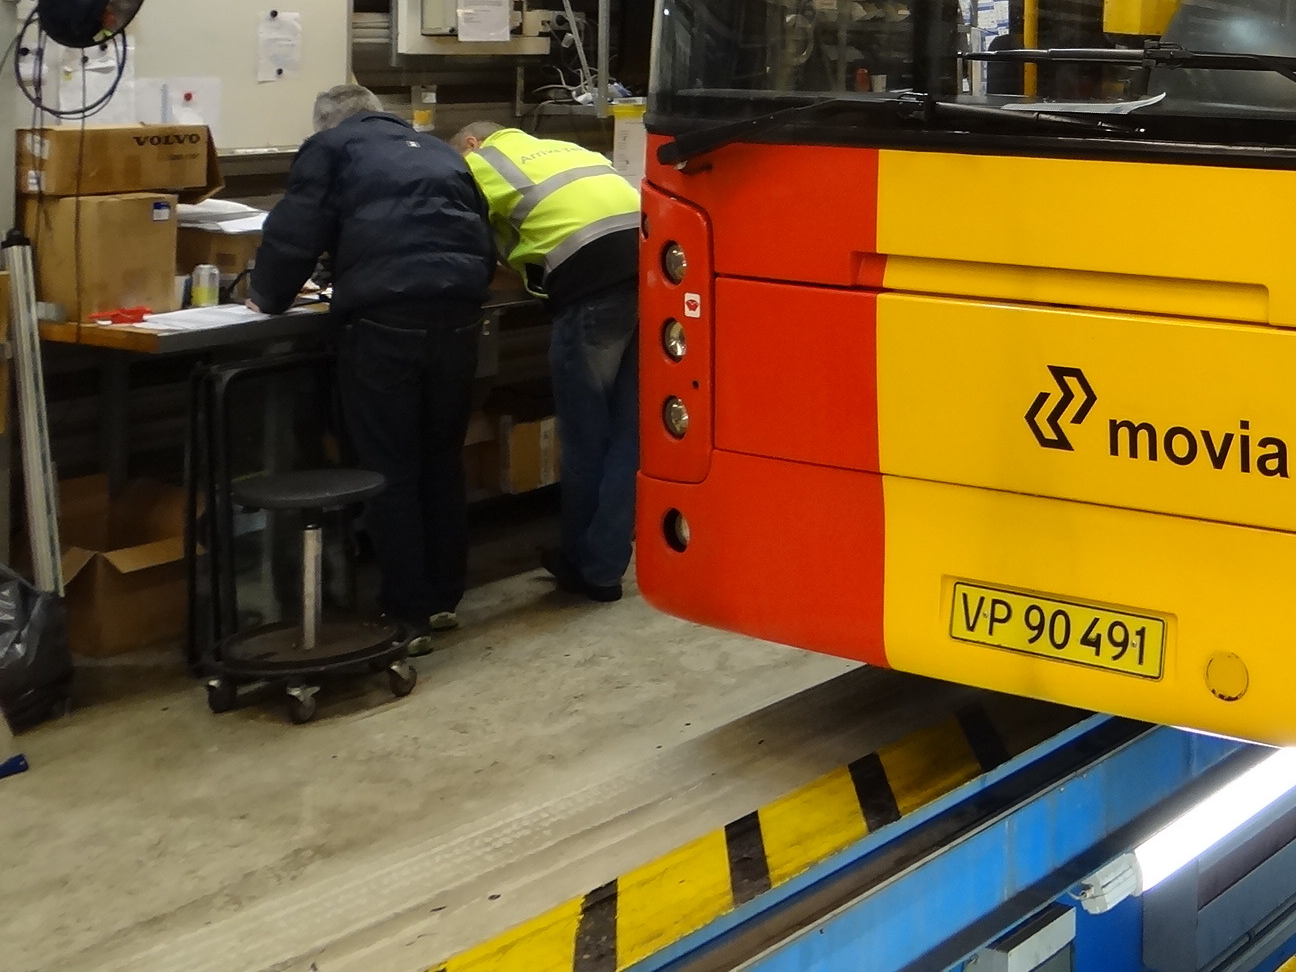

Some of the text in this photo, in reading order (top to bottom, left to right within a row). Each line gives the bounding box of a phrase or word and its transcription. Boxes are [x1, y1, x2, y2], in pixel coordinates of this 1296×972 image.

[133, 133, 201, 147] VOLVO
[1107, 419, 1291, 480] movia
[961, 592, 1147, 666] VP 90 491
